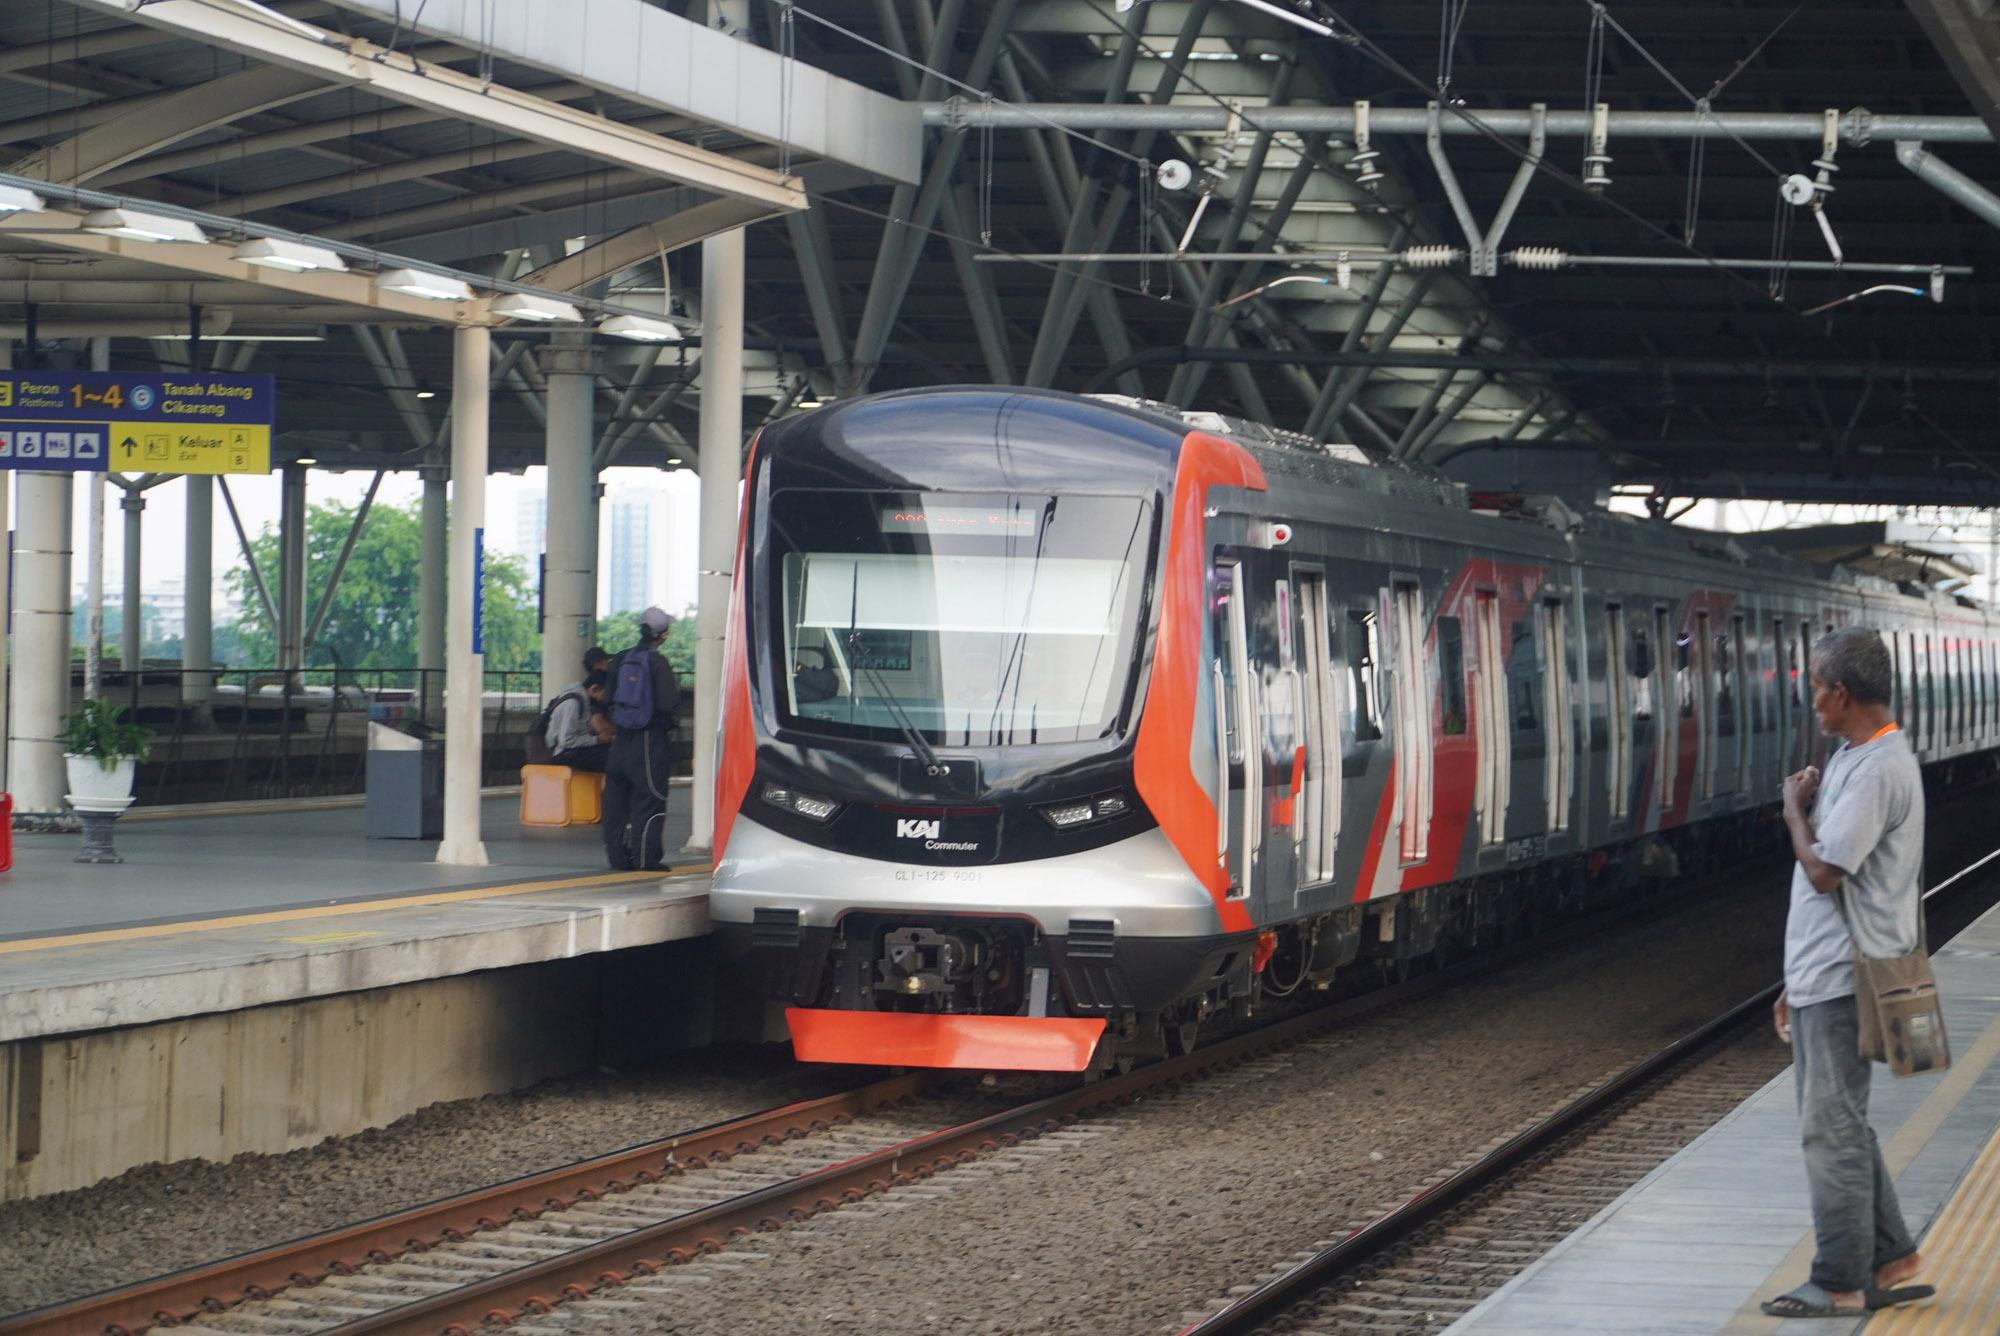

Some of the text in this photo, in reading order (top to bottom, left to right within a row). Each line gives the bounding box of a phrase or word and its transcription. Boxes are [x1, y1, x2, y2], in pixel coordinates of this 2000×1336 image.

[20, 381, 60, 395] Peron
[162, 382, 253, 400] Tanah Abang
[162, 400, 225, 417] Cikarang
[179, 435, 223, 448] Keluar
[897, 819, 940, 839] KAI
[925, 840, 979, 851] Commuter
